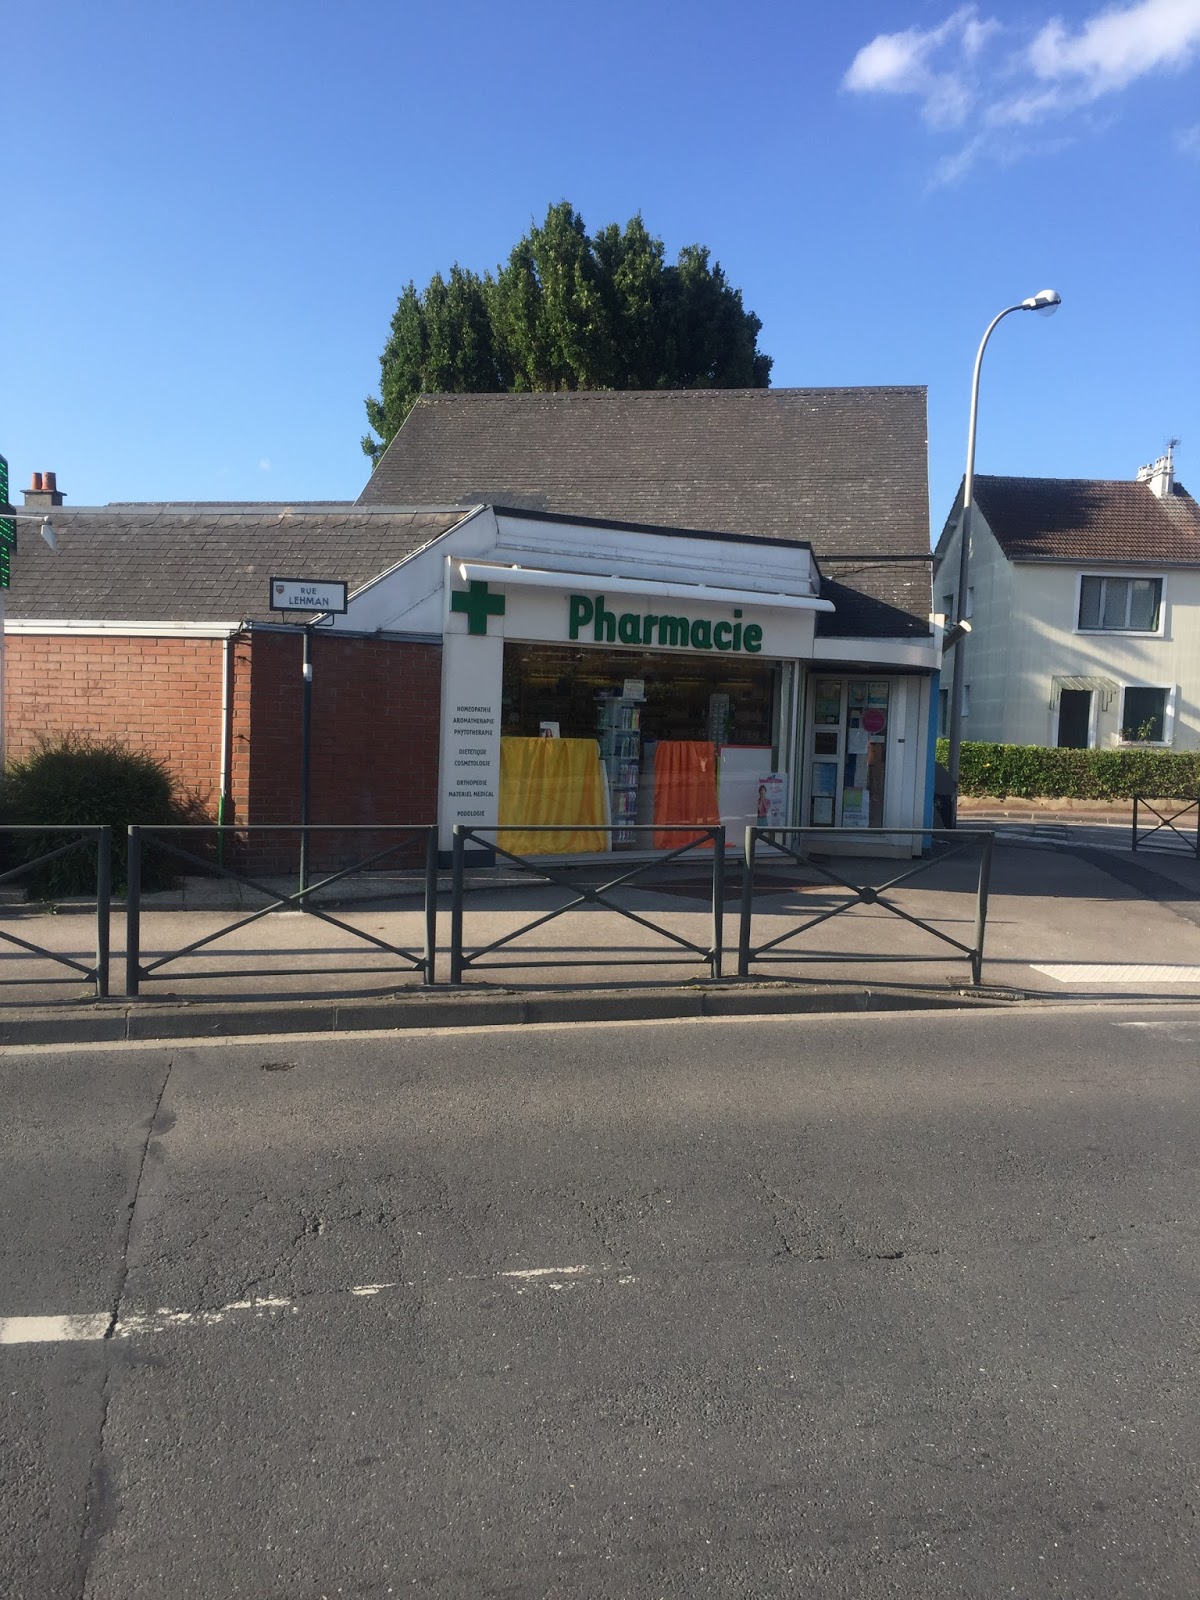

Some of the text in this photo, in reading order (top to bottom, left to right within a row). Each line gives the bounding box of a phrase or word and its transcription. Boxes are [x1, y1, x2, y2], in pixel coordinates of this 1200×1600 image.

[300, 587, 317, 595] RUE
[288, 596, 329, 606] LEHMAN
[568, 594, 763, 653] Pharmacie
[458, 748, 487, 756] DIETETIQUE
